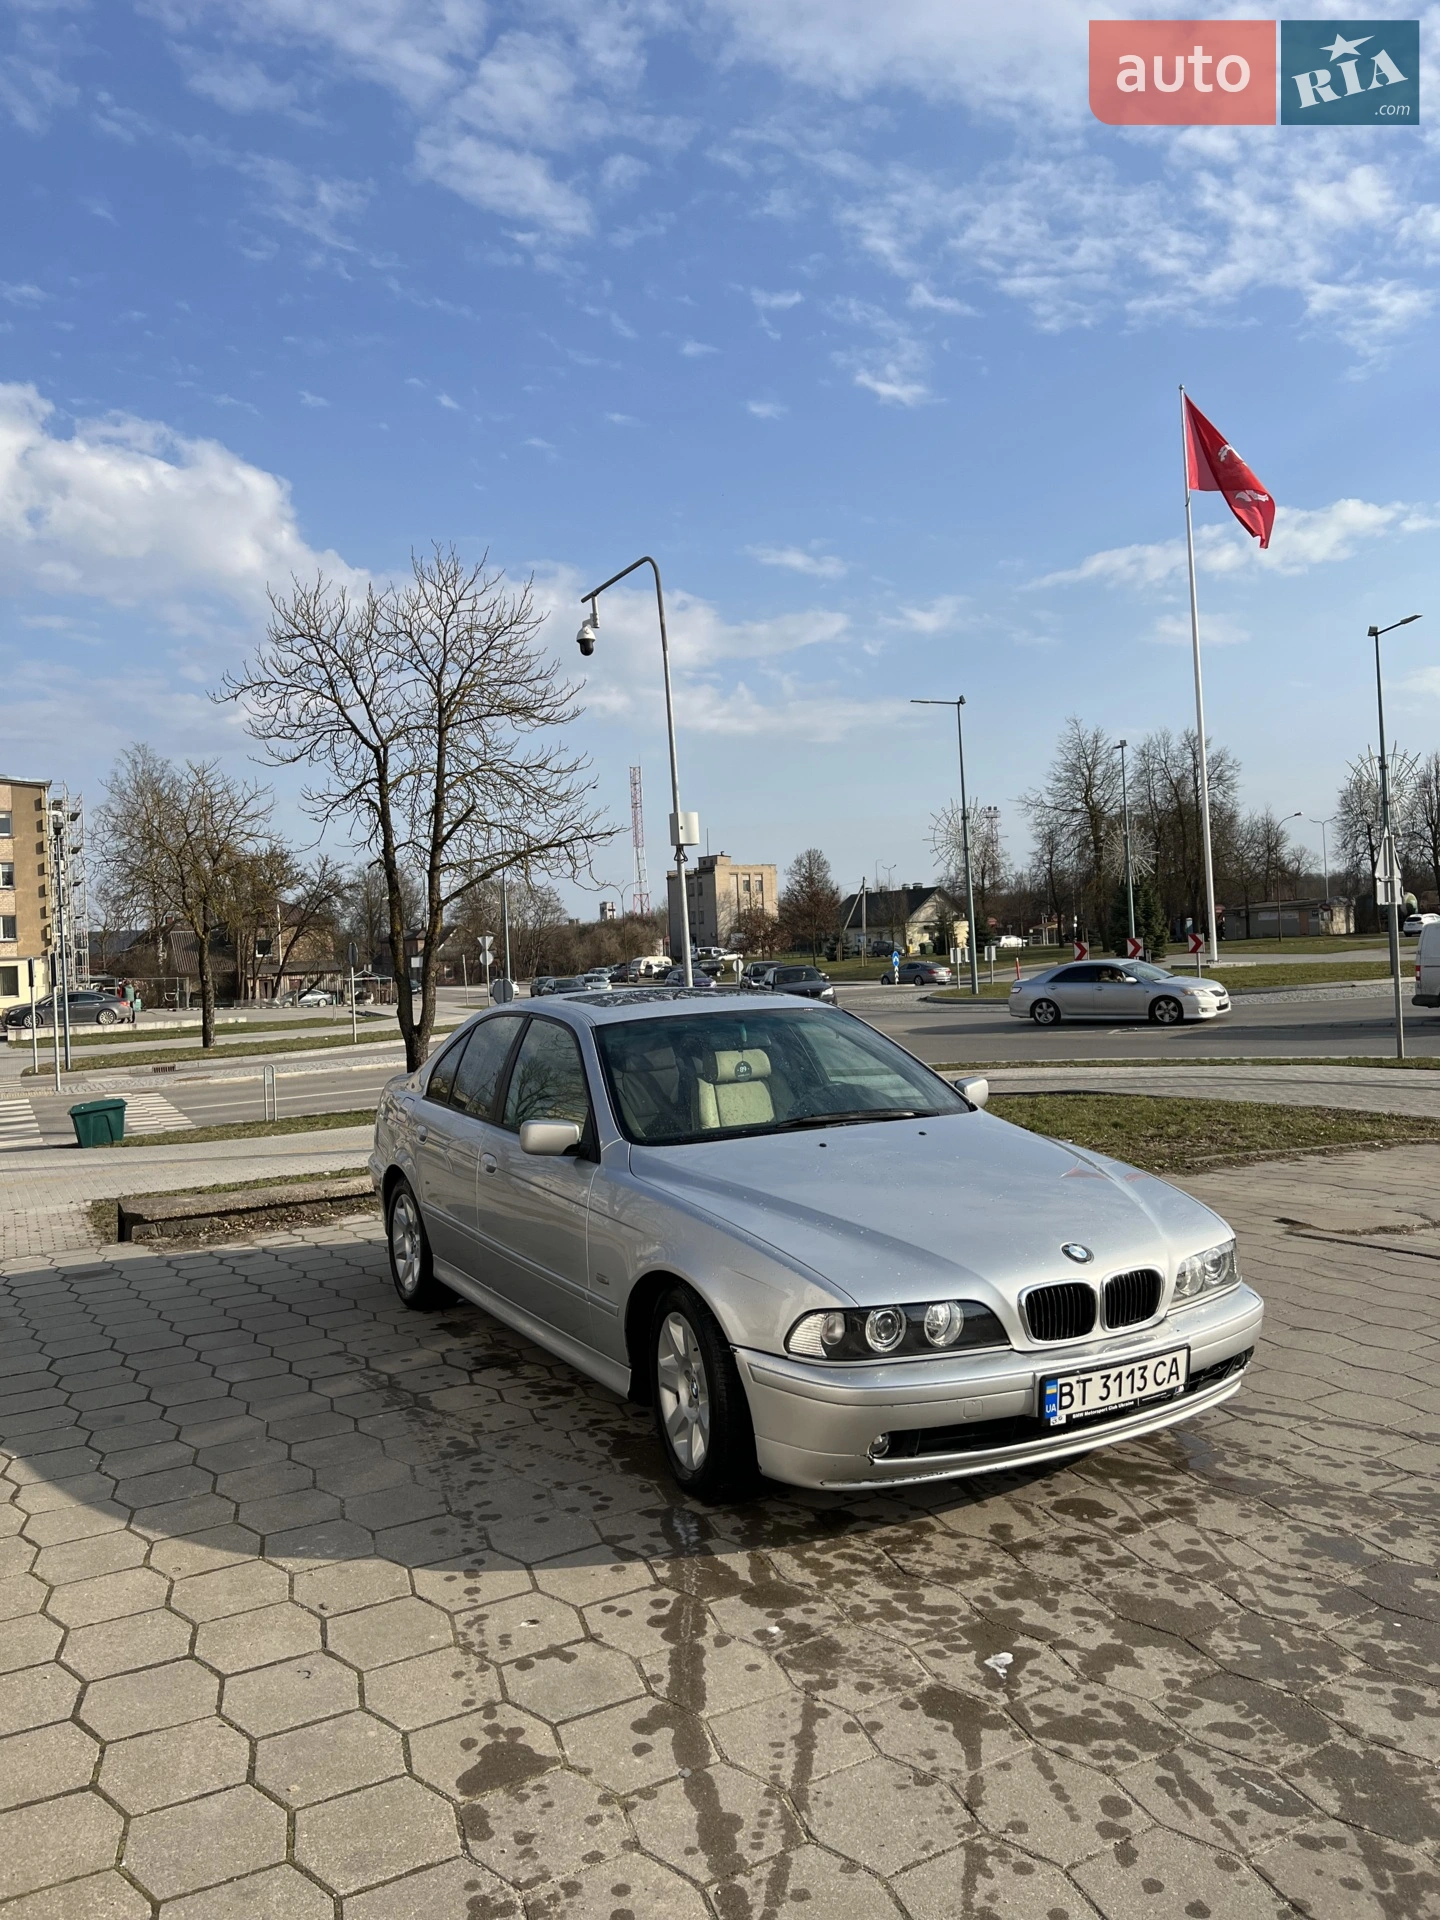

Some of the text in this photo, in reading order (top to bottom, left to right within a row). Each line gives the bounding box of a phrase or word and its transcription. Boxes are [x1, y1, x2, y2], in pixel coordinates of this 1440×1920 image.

[1058, 1357, 1180, 1411] BT 3113 CA
[1045, 1403, 1057, 1414] UA
[1084, 1406, 1108, 1416] Motorsport
[1118, 1400, 1134, 1408] Ukraine
